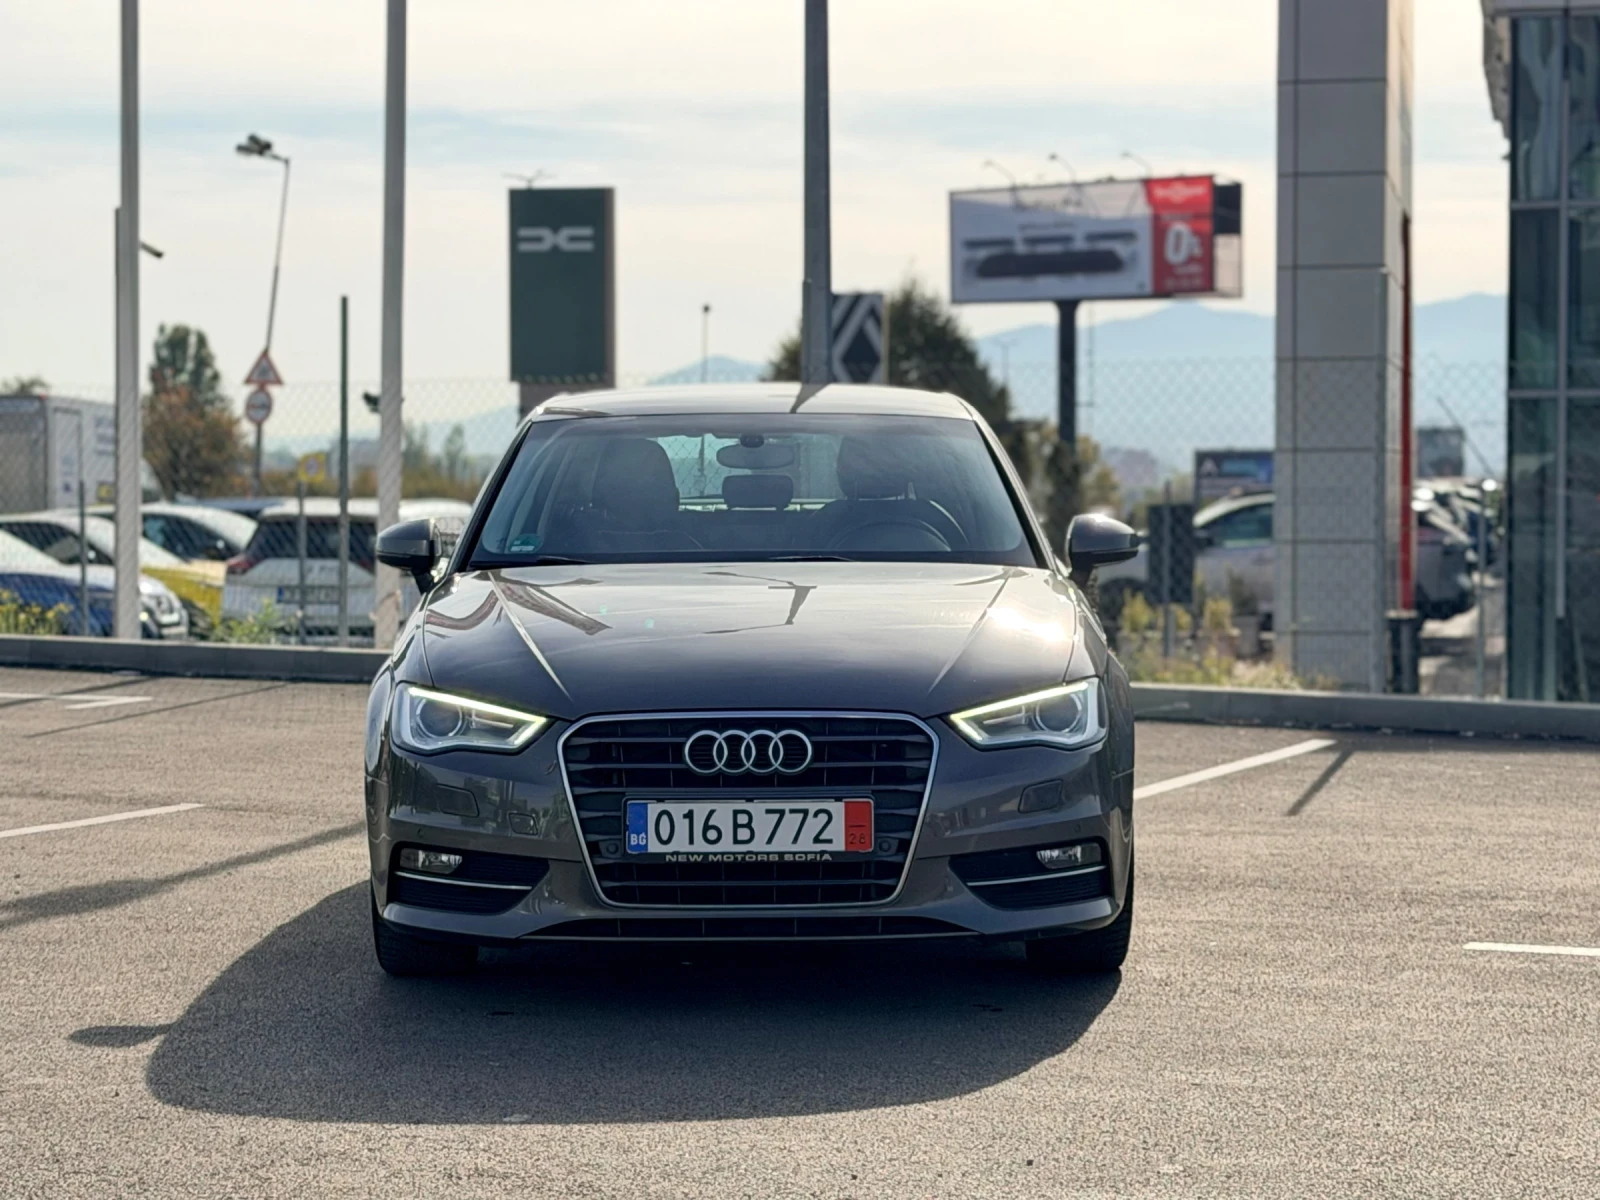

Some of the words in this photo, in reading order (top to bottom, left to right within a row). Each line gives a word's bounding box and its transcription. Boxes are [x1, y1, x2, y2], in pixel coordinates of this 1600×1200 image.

[630, 833, 647, 845] BG
[849, 832, 866, 845] 28
[665, 854, 704, 862] NEW
[708, 853, 779, 862] MOTORS
[784, 853, 833, 861] SOFIA
